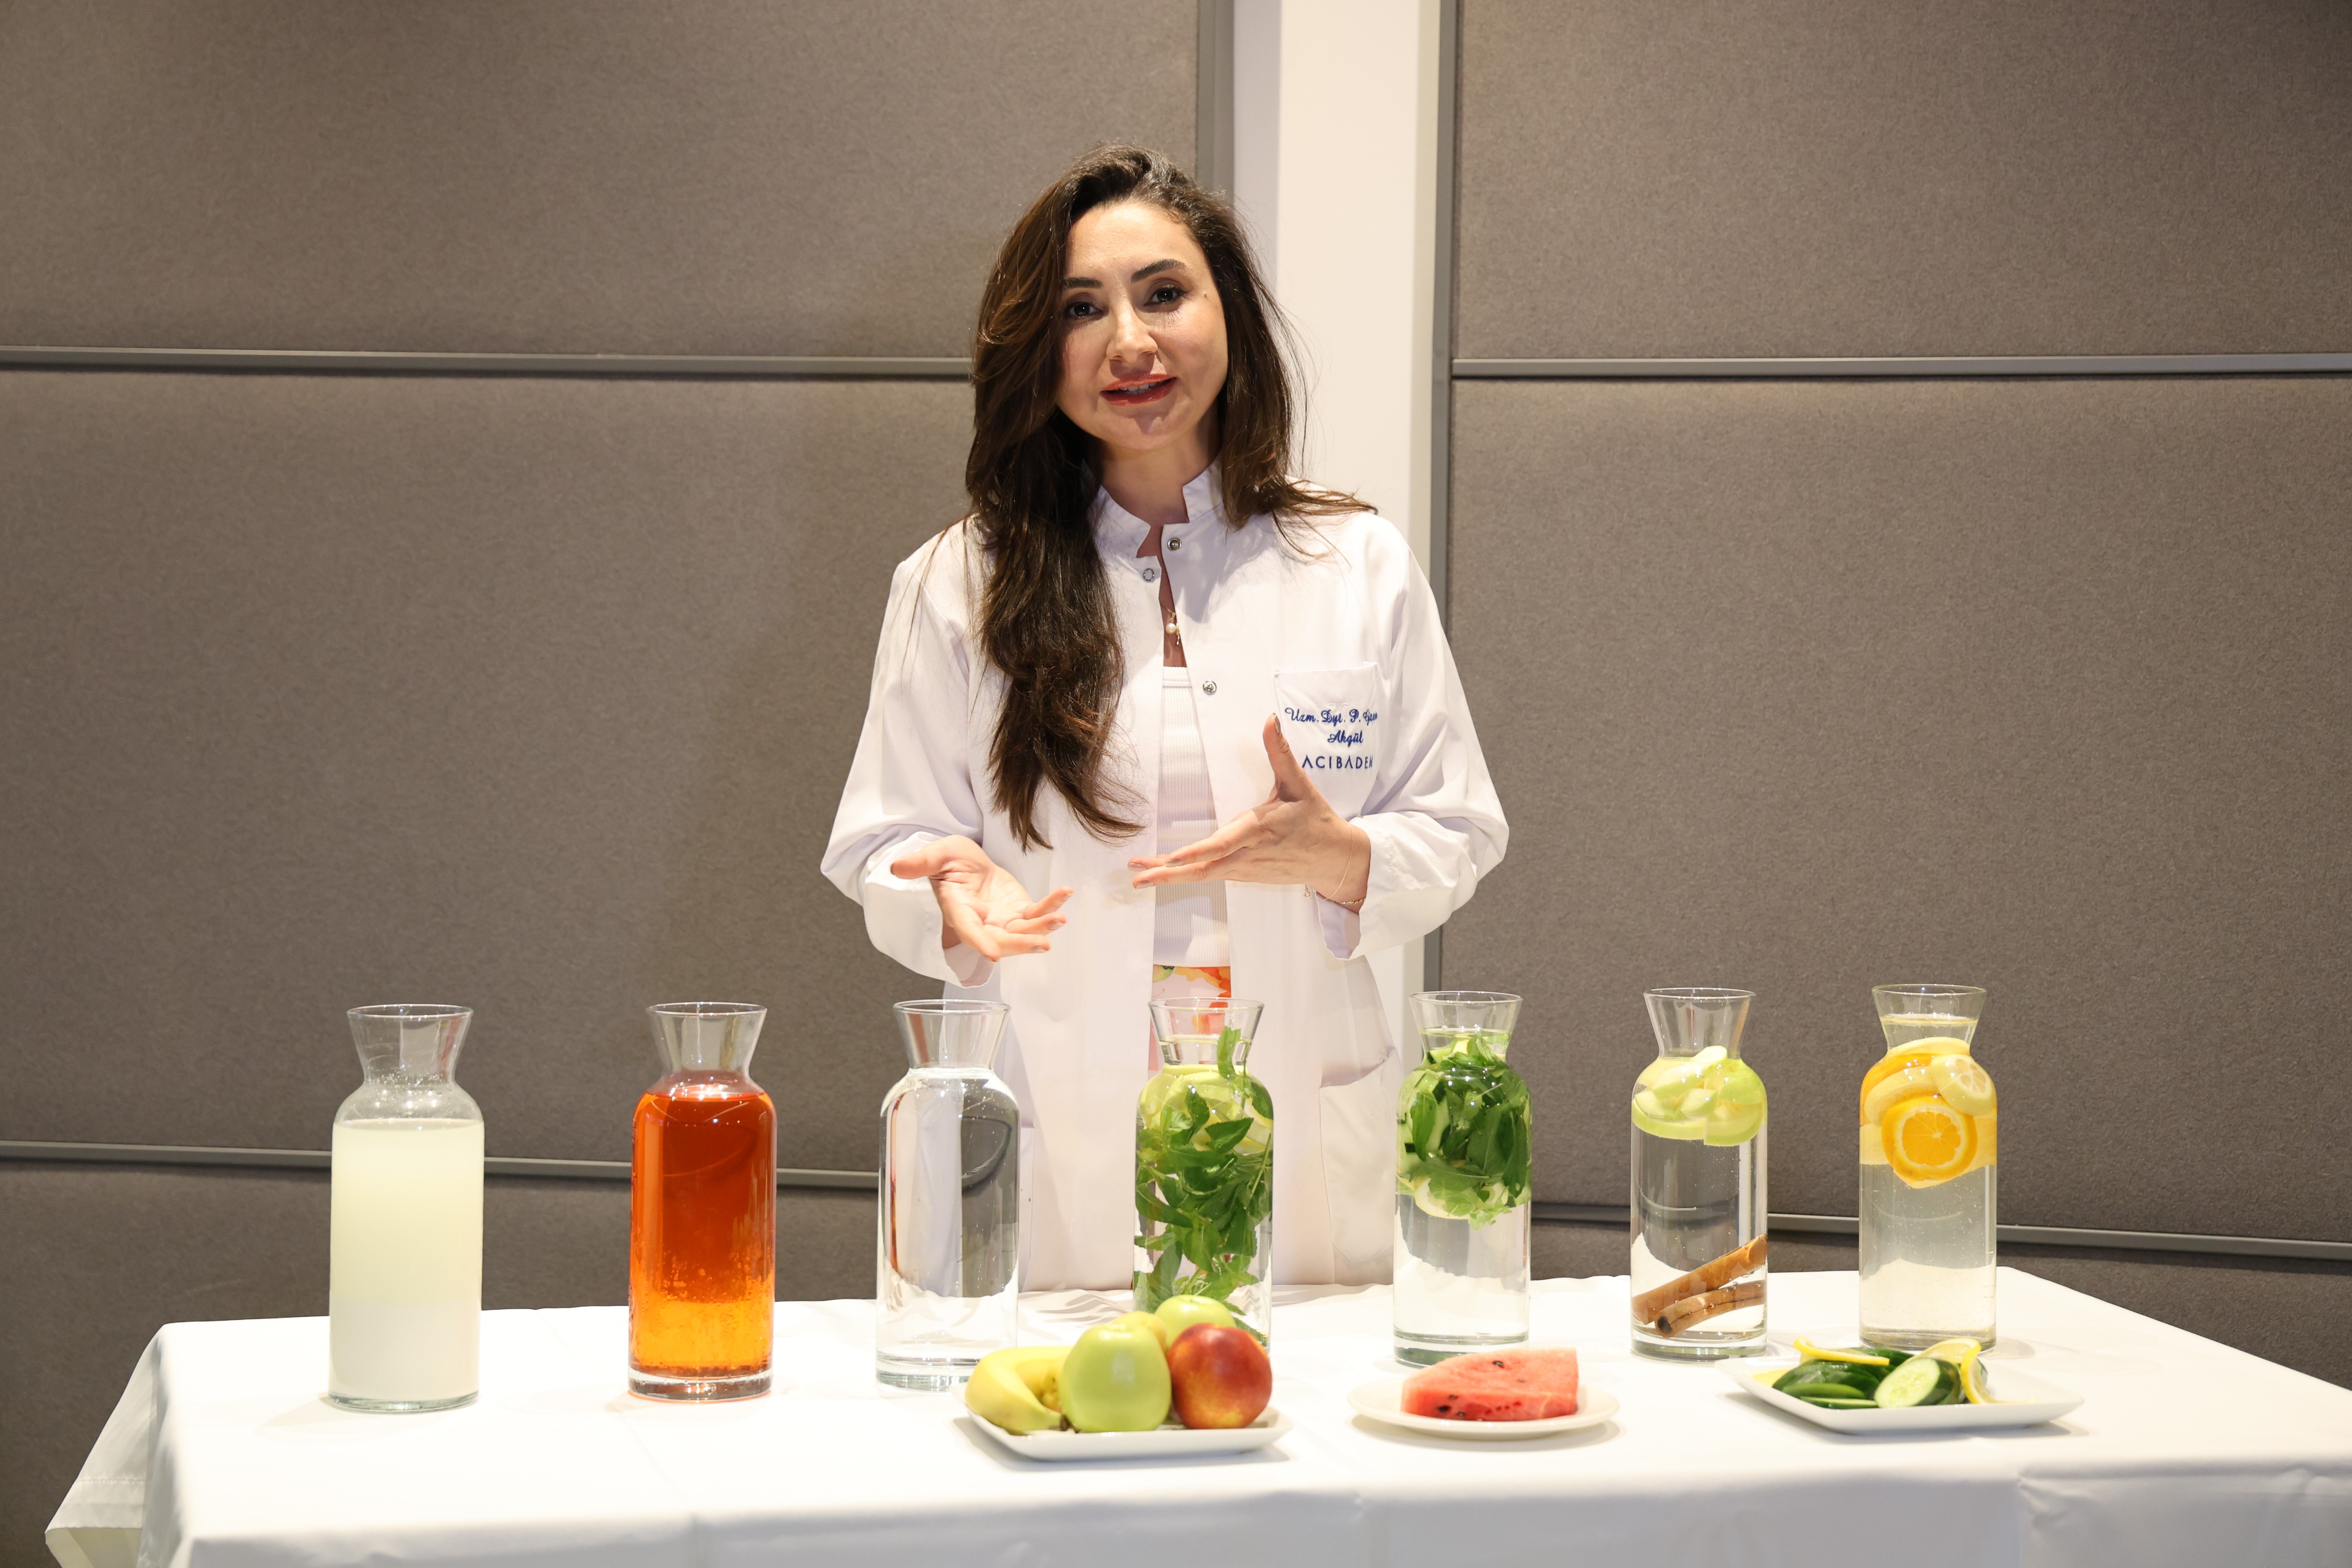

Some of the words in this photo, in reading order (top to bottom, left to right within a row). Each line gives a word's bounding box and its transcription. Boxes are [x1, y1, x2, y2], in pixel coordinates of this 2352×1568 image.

[1284, 707, 1319, 723] Uzm.
[1320, 709, 1346, 727] Dyt.
[1349, 708, 1361, 723] P.
[1327, 730, 1364, 748] Akgül
[1301, 754, 1373, 769] ACIBADEM
